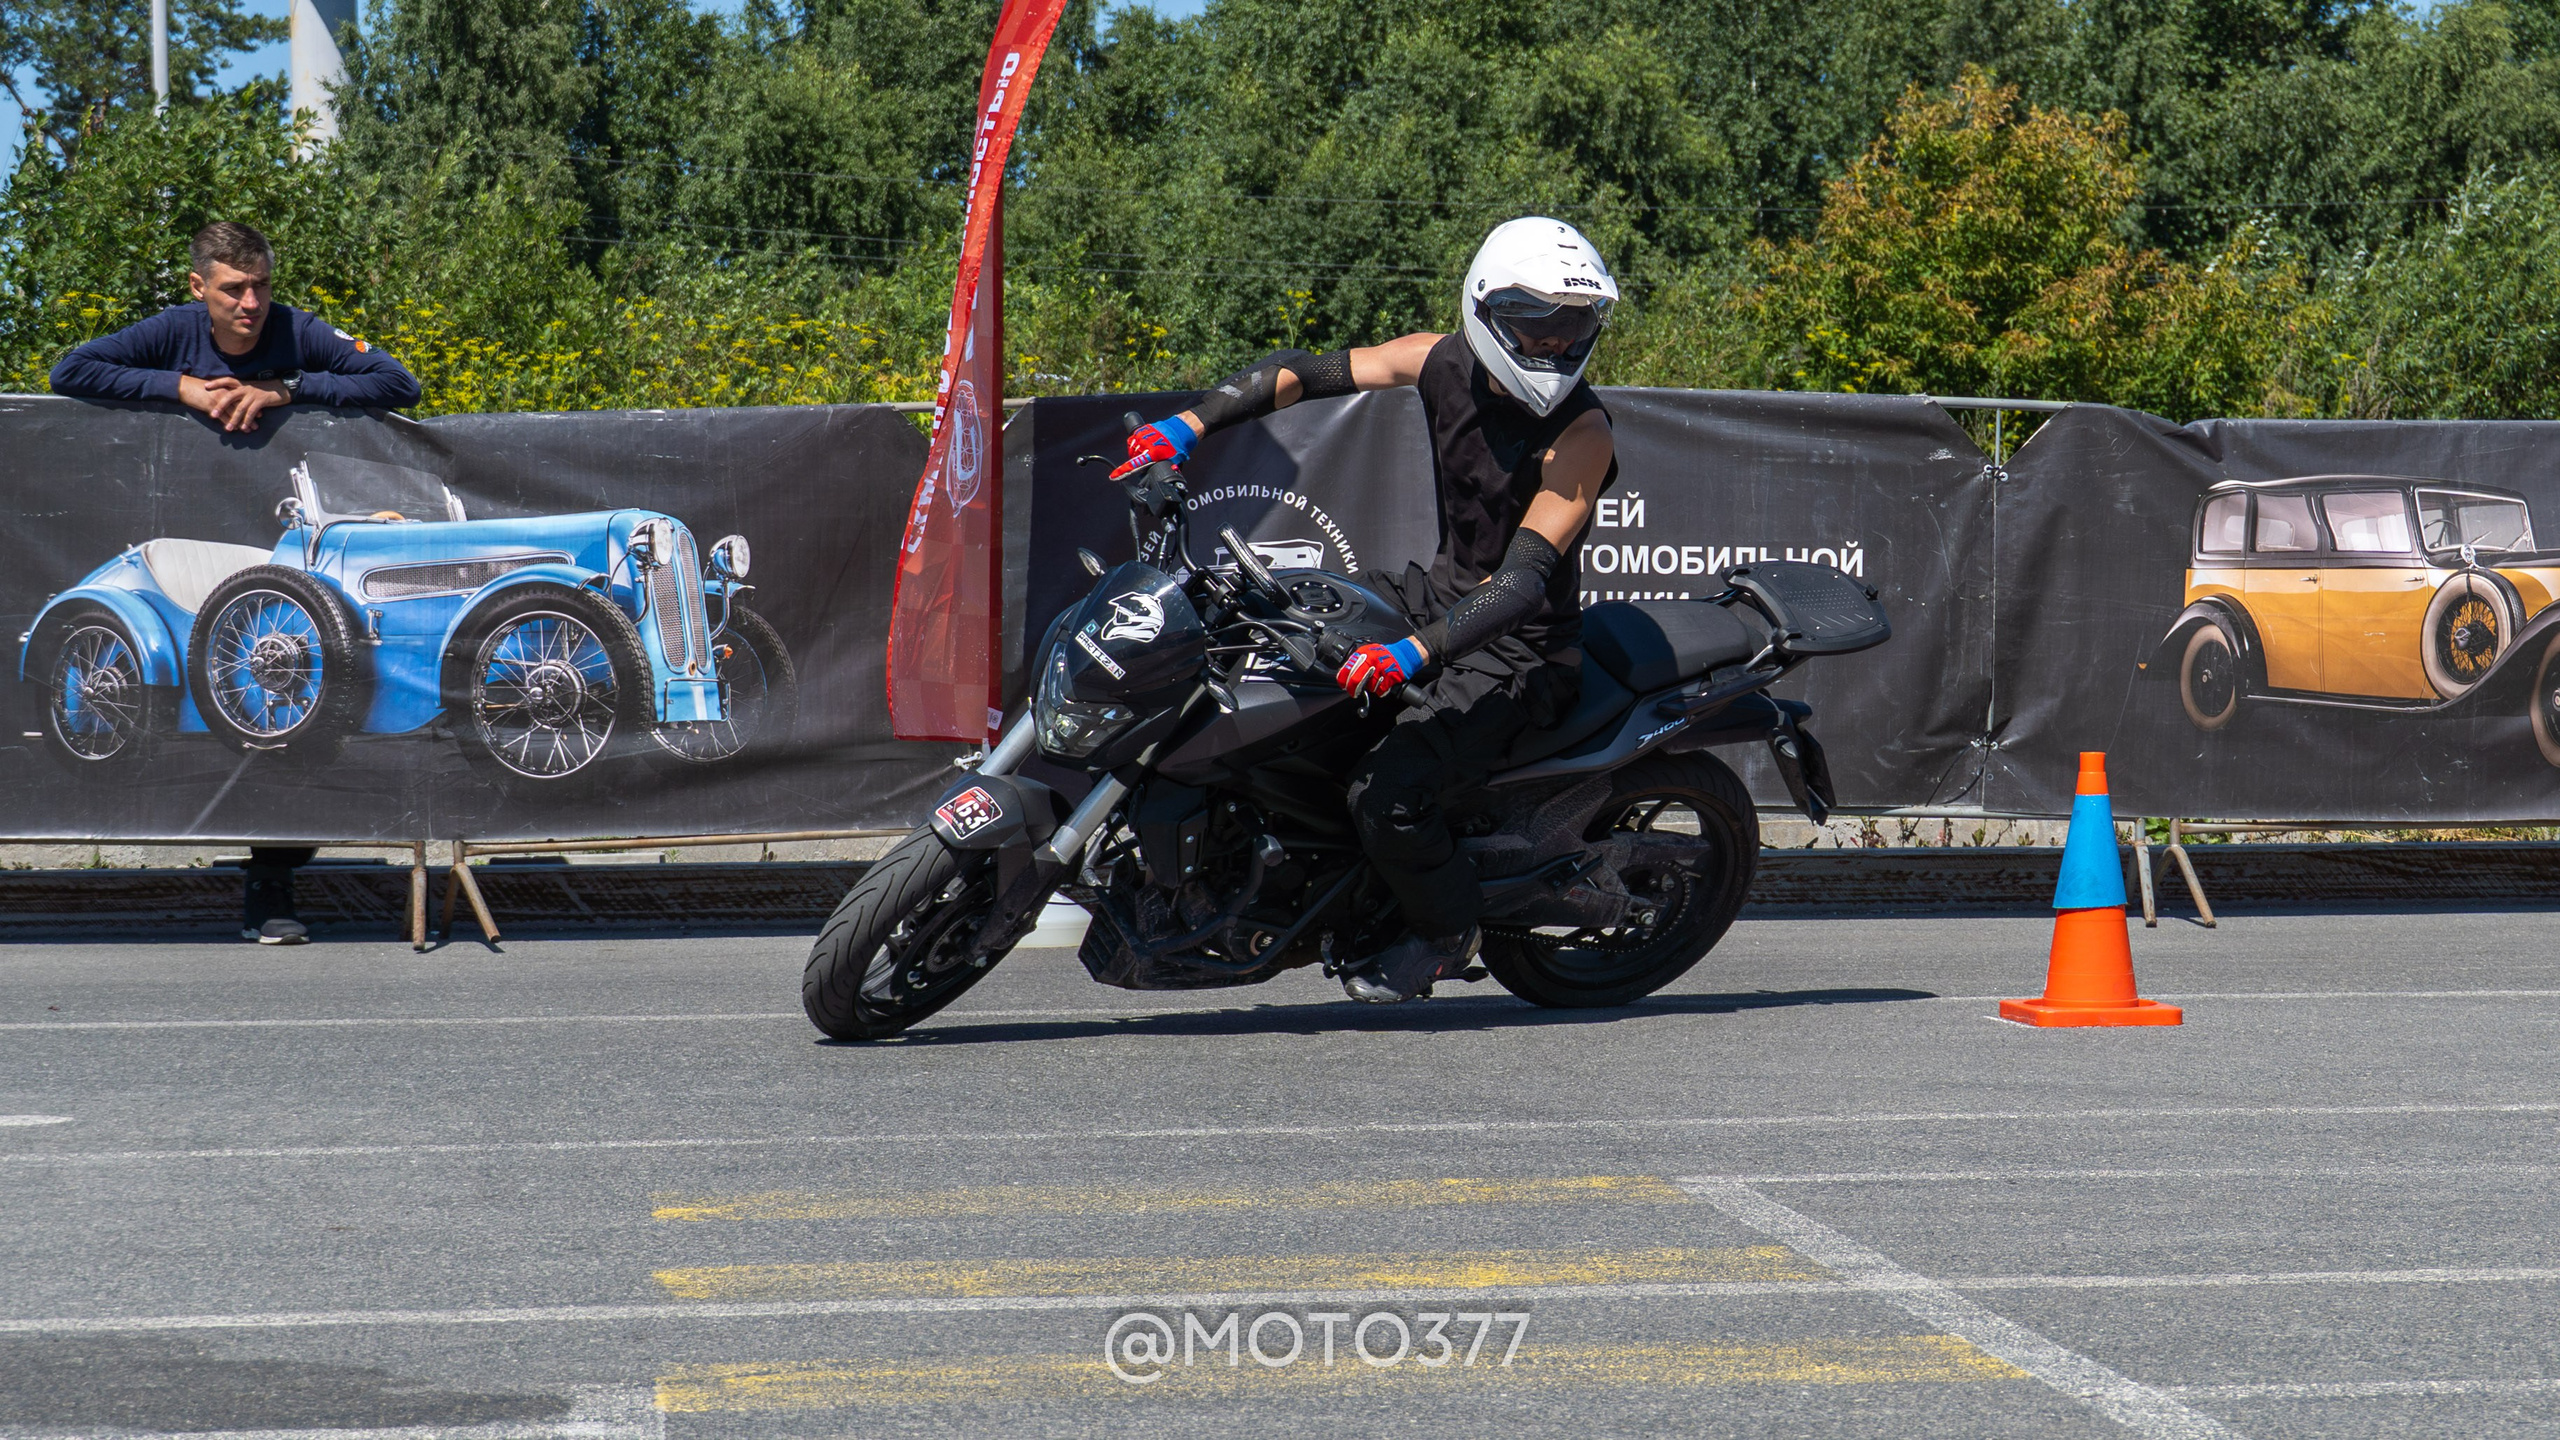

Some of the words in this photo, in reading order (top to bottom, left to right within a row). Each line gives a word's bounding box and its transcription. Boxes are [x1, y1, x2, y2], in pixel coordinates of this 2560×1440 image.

[1596, 491, 1645, 528] ЕЙ
[1140, 530, 1162, 562] ЗЕЙ
[1186, 484, 1308, 512] ОМОБИЛЬНОЙ
[1312, 505, 1359, 575] ТЕХНИКИ
[956, 800, 990, 829] 63
